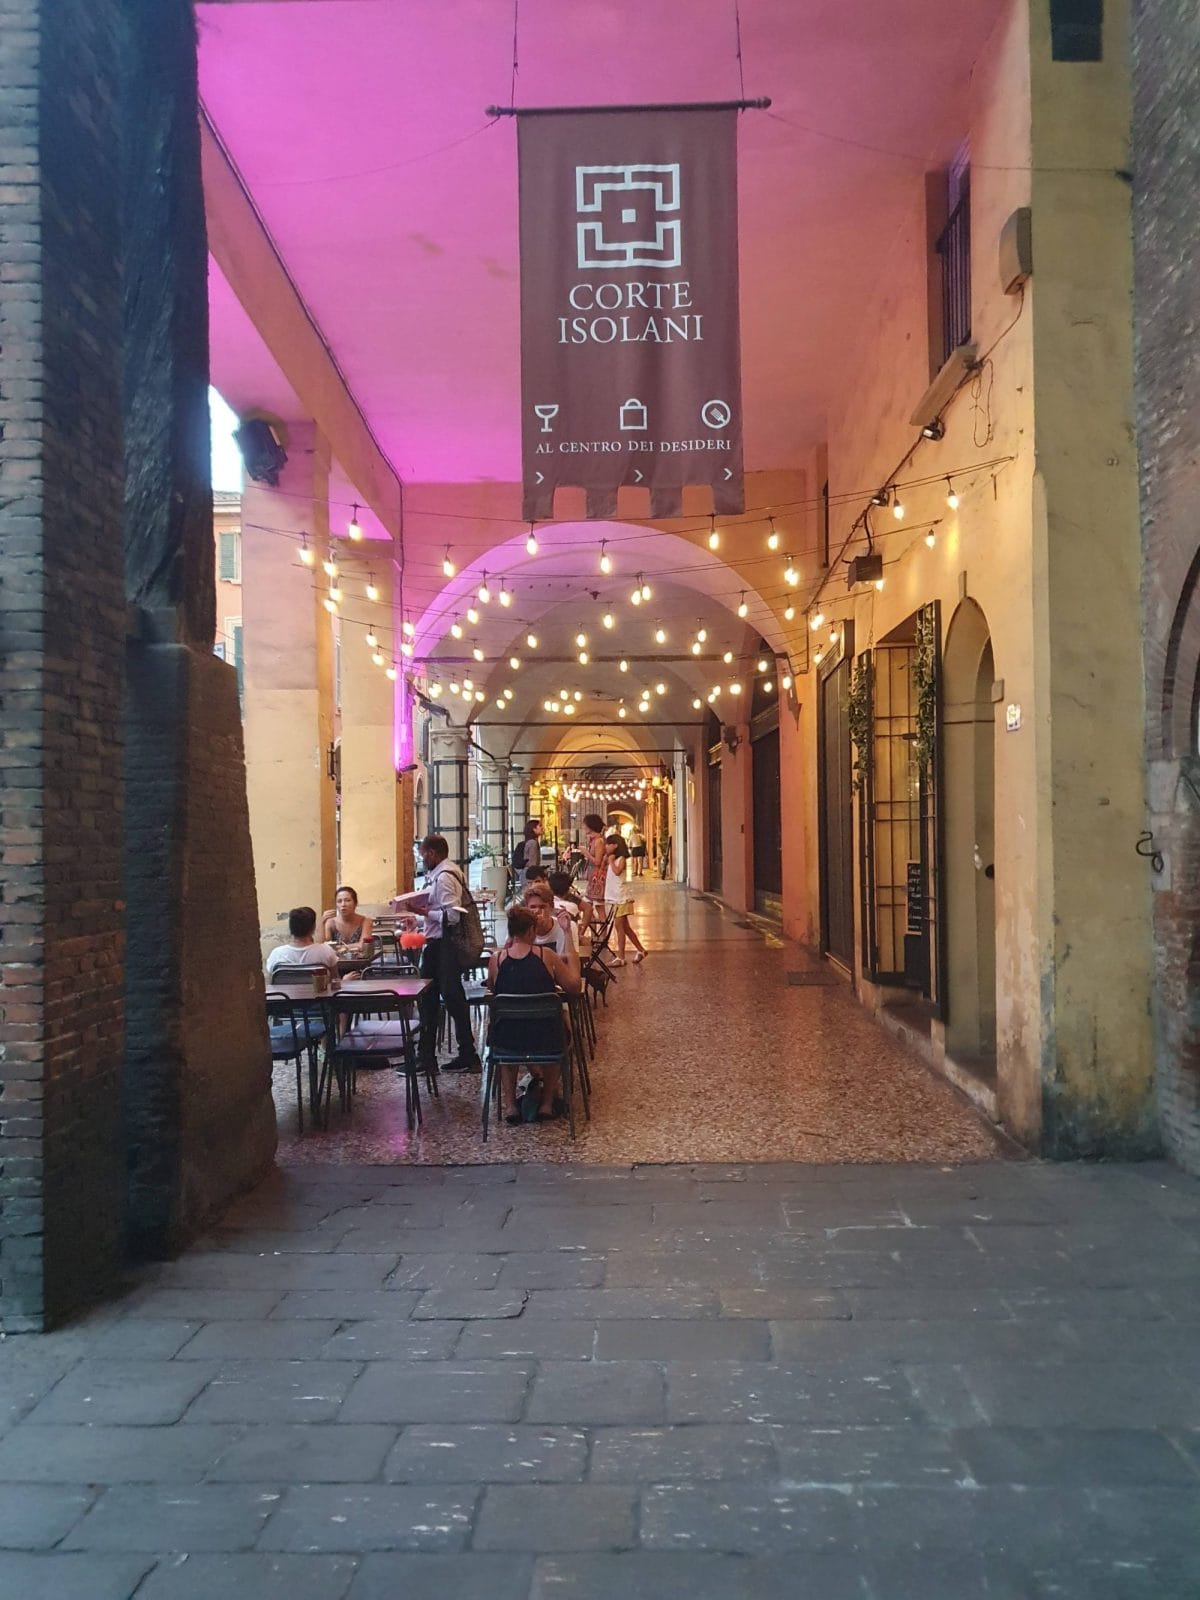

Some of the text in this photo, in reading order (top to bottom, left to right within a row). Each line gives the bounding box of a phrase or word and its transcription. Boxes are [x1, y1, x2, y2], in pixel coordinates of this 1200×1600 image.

[569, 281, 693, 310] CORTE
[558, 315, 704, 344] ISOLANI
[535, 439, 732, 454] AL CENTRO DEI DESIDERI
